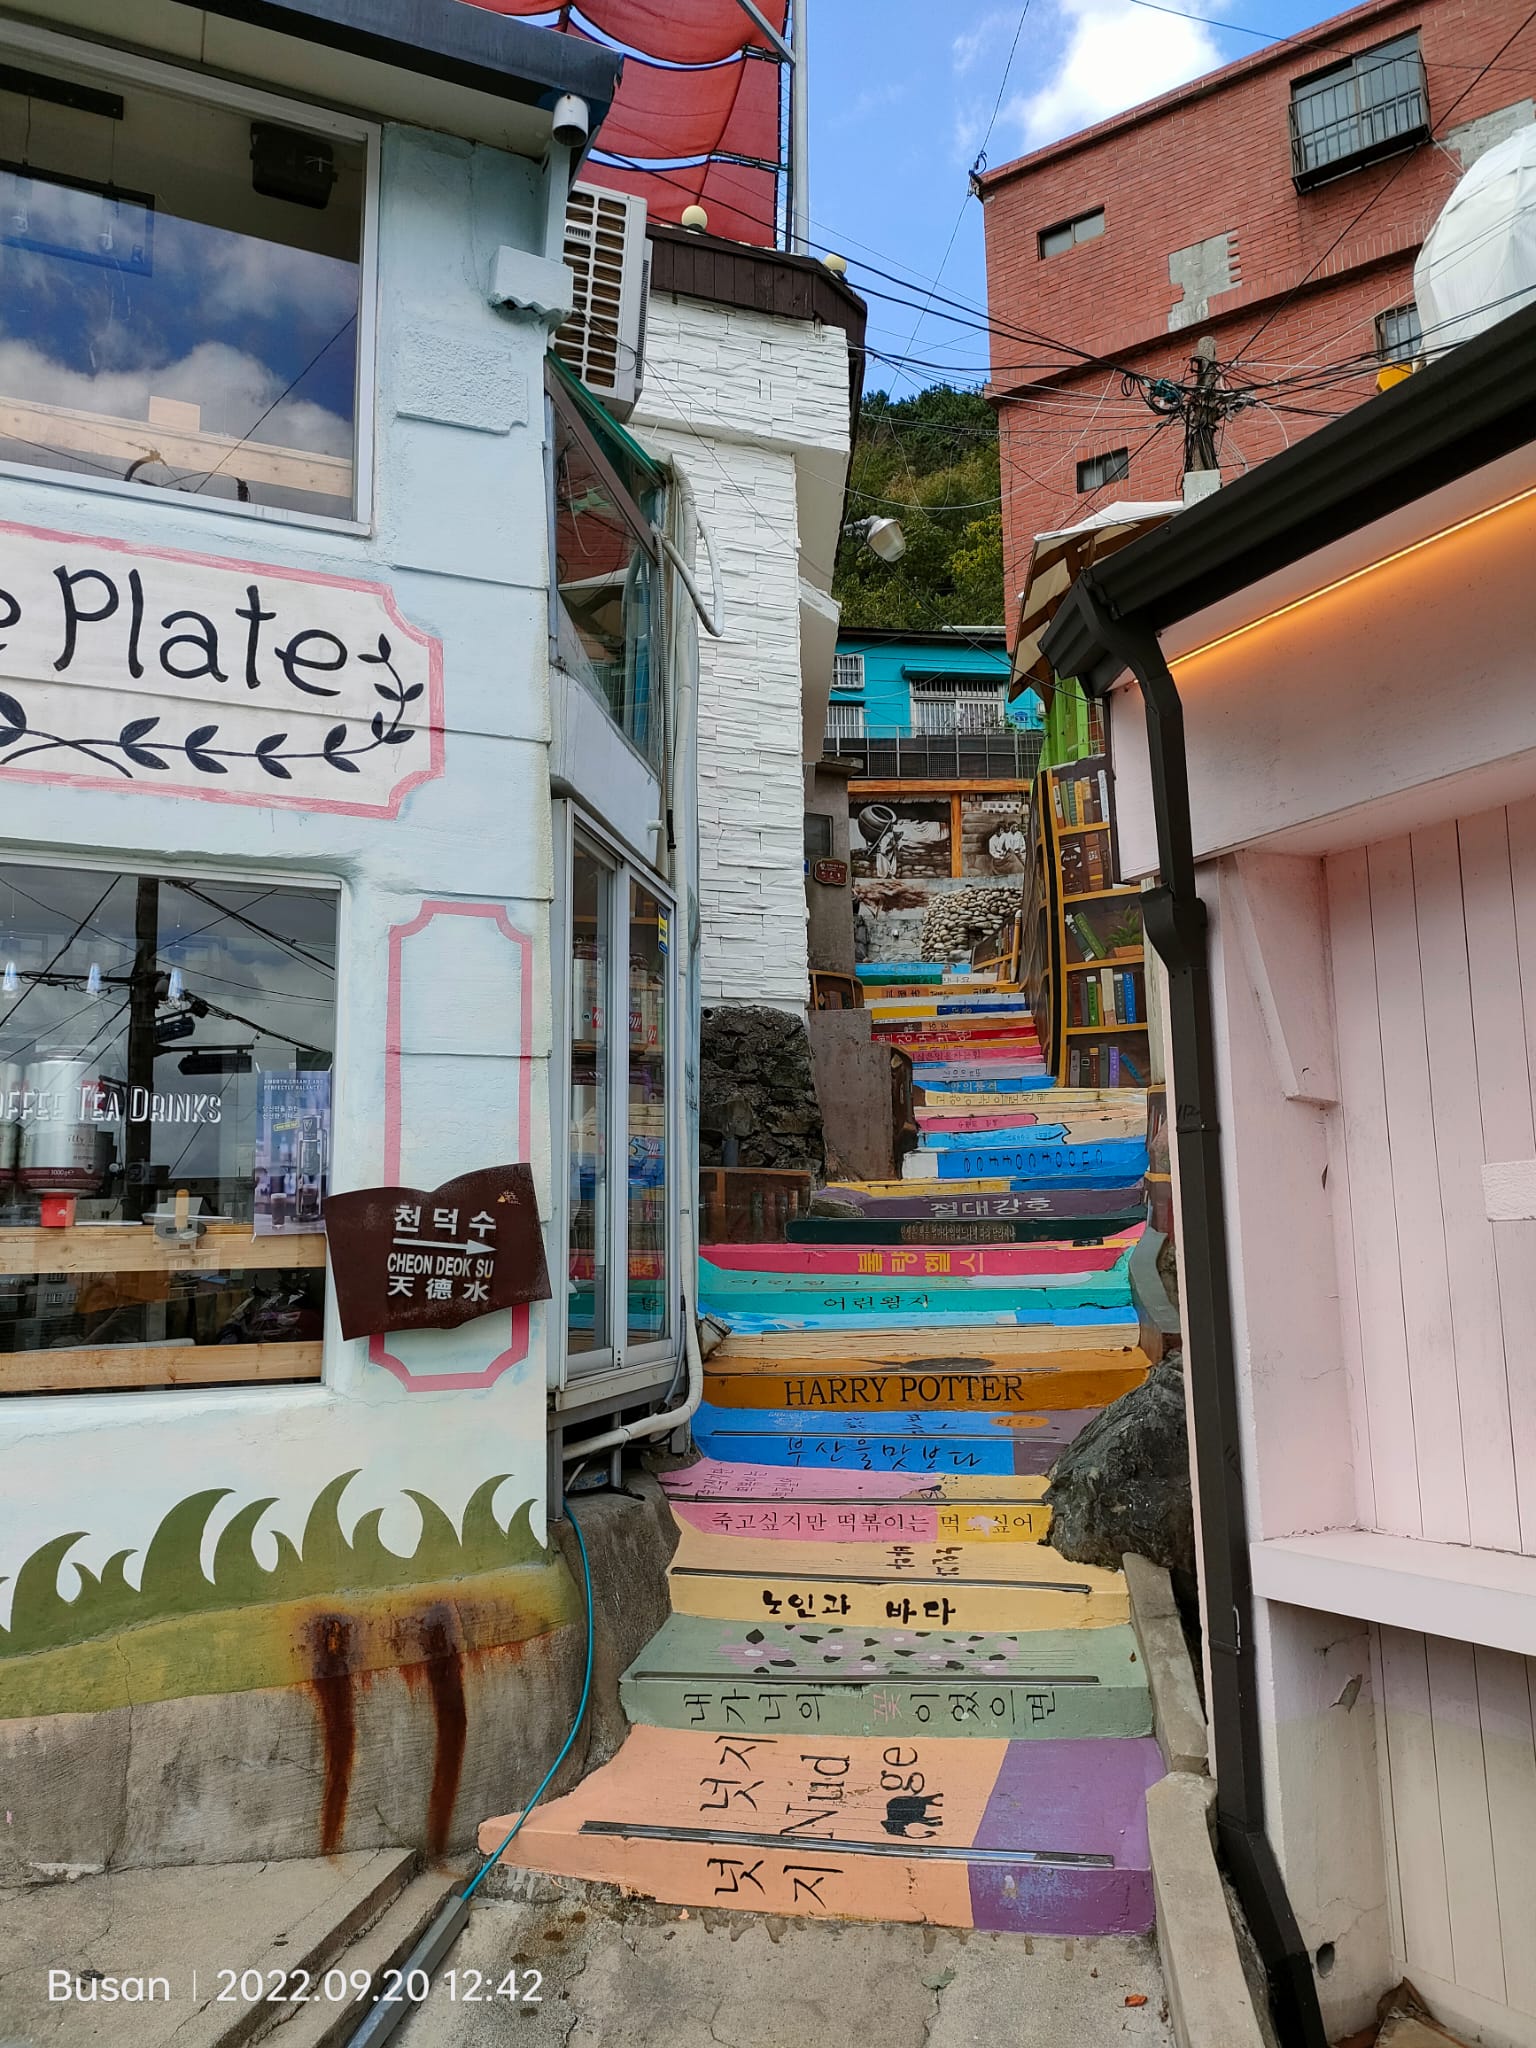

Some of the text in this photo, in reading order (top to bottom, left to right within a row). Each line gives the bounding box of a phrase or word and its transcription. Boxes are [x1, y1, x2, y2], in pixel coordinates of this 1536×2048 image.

[53, 565, 348, 696] Plate
[930, 1197, 1055, 1217] 절대강호
[387, 1252, 495, 1279] CHEON DEOK SU
[784, 1375, 1025, 1406] HARRY POTTER
[838, 1513, 931, 1533] 떡볶이는
[762, 1590, 957, 1625] 노인과 바다
